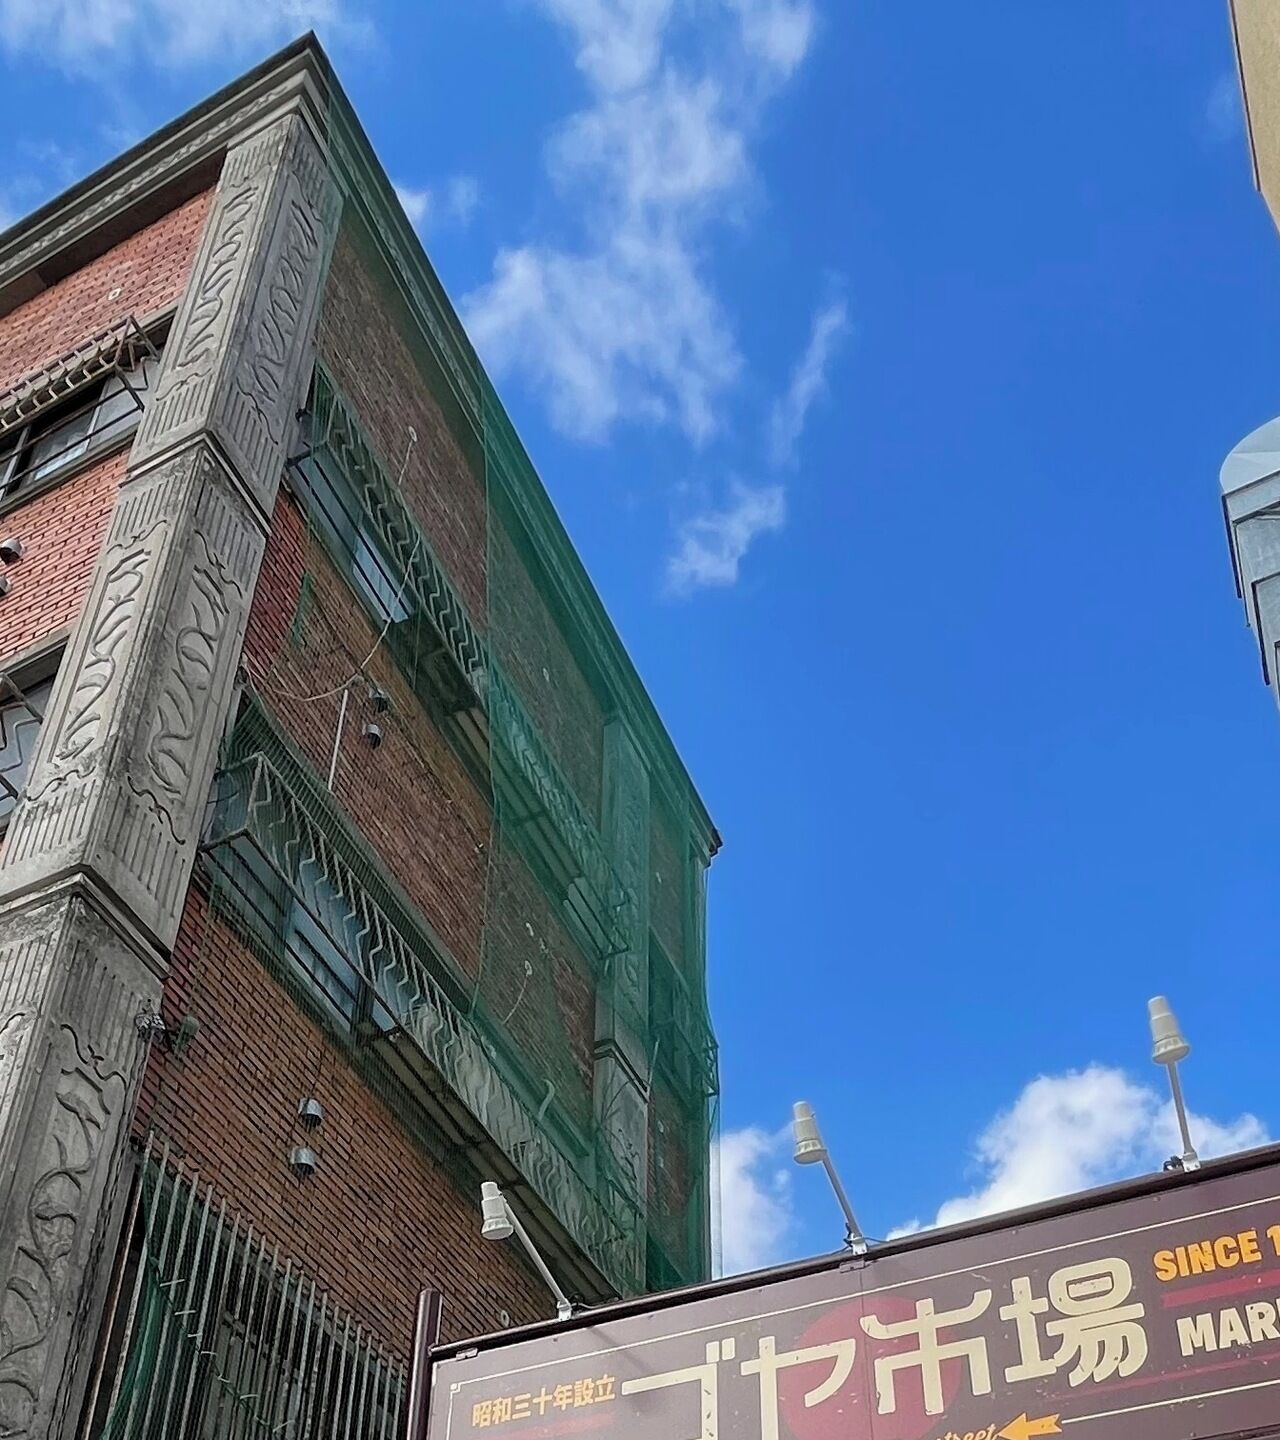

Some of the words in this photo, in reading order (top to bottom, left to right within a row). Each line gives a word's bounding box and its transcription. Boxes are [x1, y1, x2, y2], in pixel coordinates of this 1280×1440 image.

[1152, 1229, 1262, 1283] SINCE
[472, 1373, 618, 1429] 昭和三十年設立
